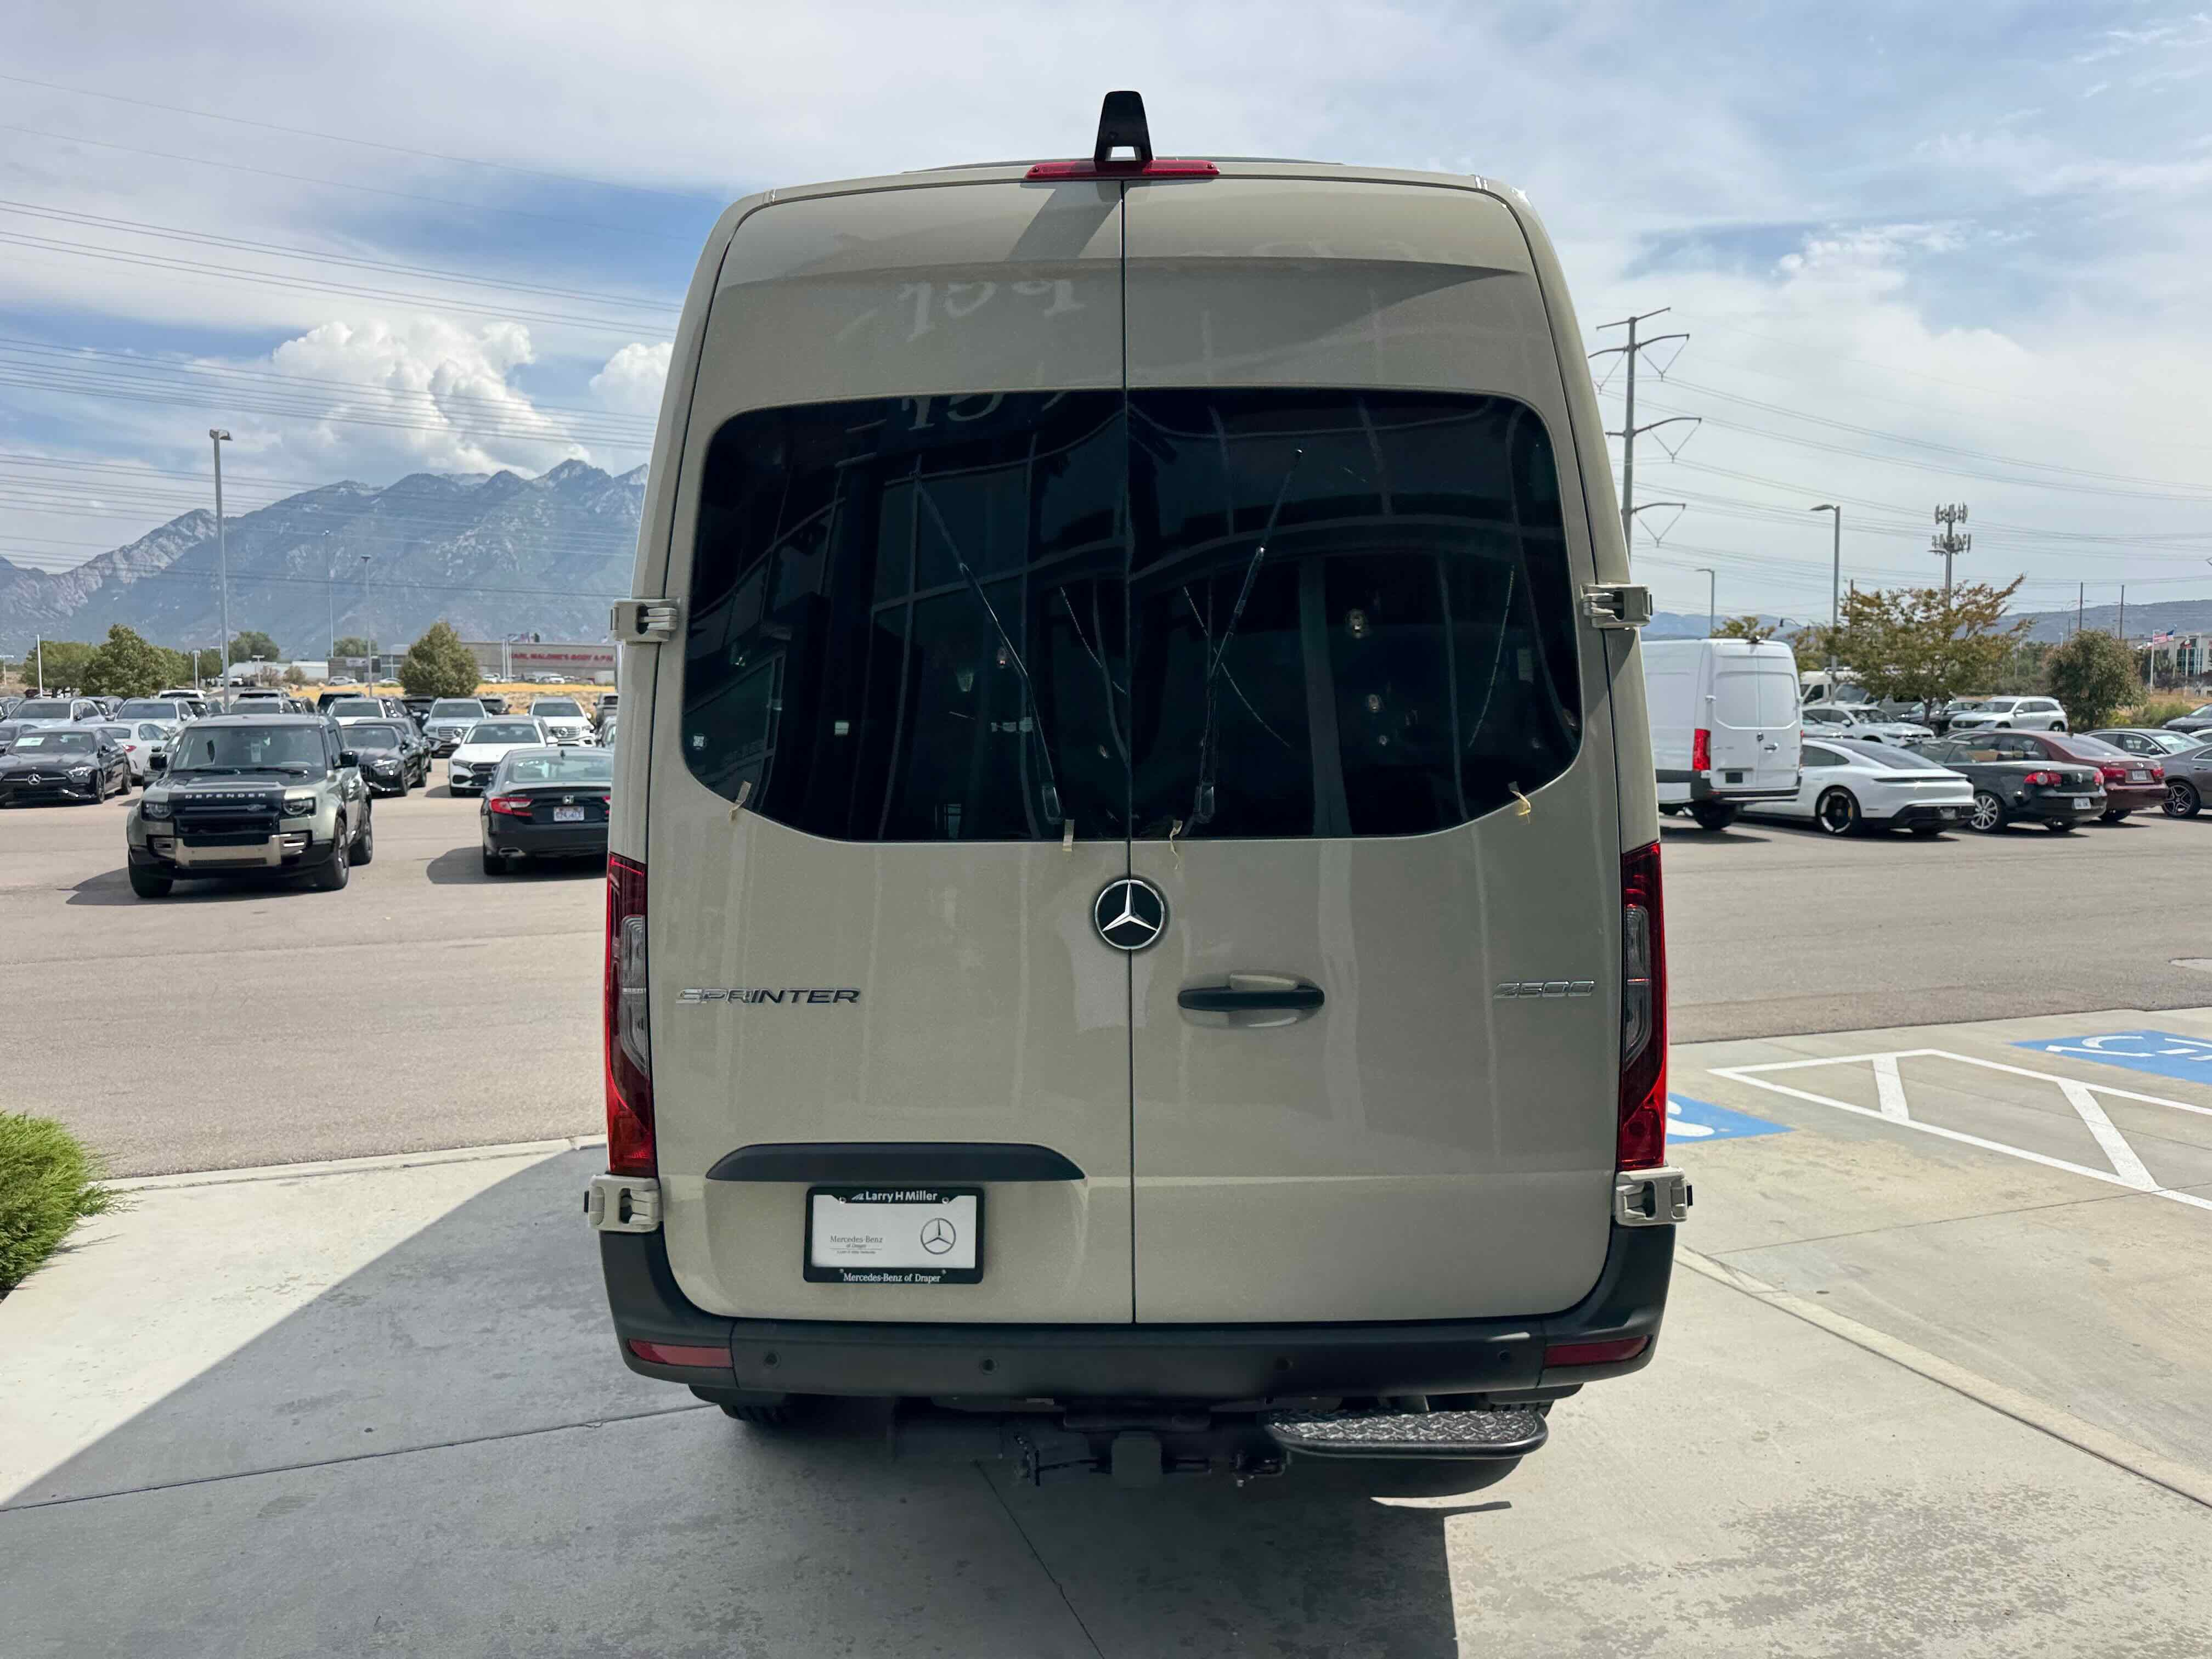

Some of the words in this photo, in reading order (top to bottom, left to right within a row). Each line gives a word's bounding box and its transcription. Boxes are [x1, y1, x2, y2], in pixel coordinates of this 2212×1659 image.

[675, 988, 861, 1004] SPRINTER
[865, 1190, 894, 1203] Larry
[895, 1191, 904, 1200] H
[905, 1190, 938, 1201] Miller
[843, 1272, 903, 1282] Mercedes-Benz
[905, 1273, 913, 1282] of
[915, 1273, 941, 1285] Draper
